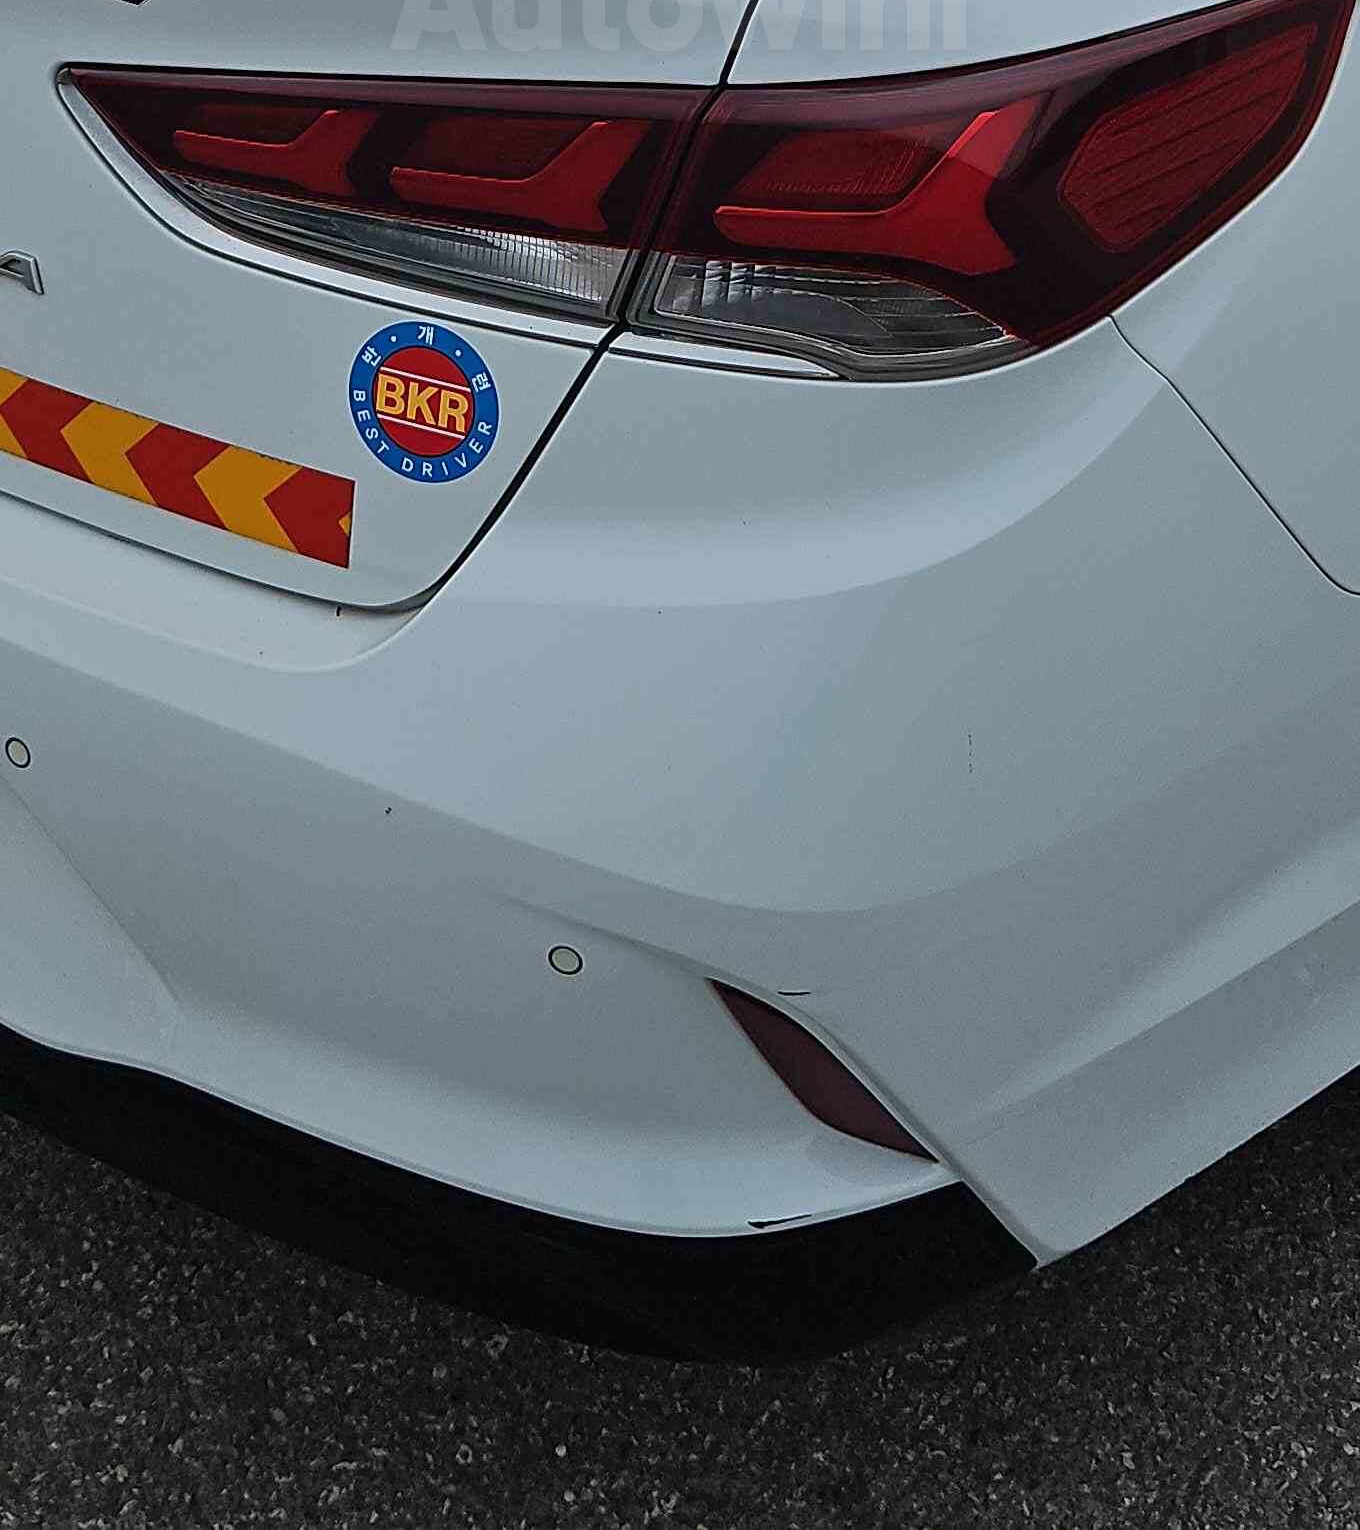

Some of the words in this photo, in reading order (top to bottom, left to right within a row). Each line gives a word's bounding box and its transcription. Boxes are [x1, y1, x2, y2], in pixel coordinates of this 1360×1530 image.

[353, 389, 390, 456] BEST
[401, 421, 493, 478] DRIVER
[375, 372, 470, 433] BKR
